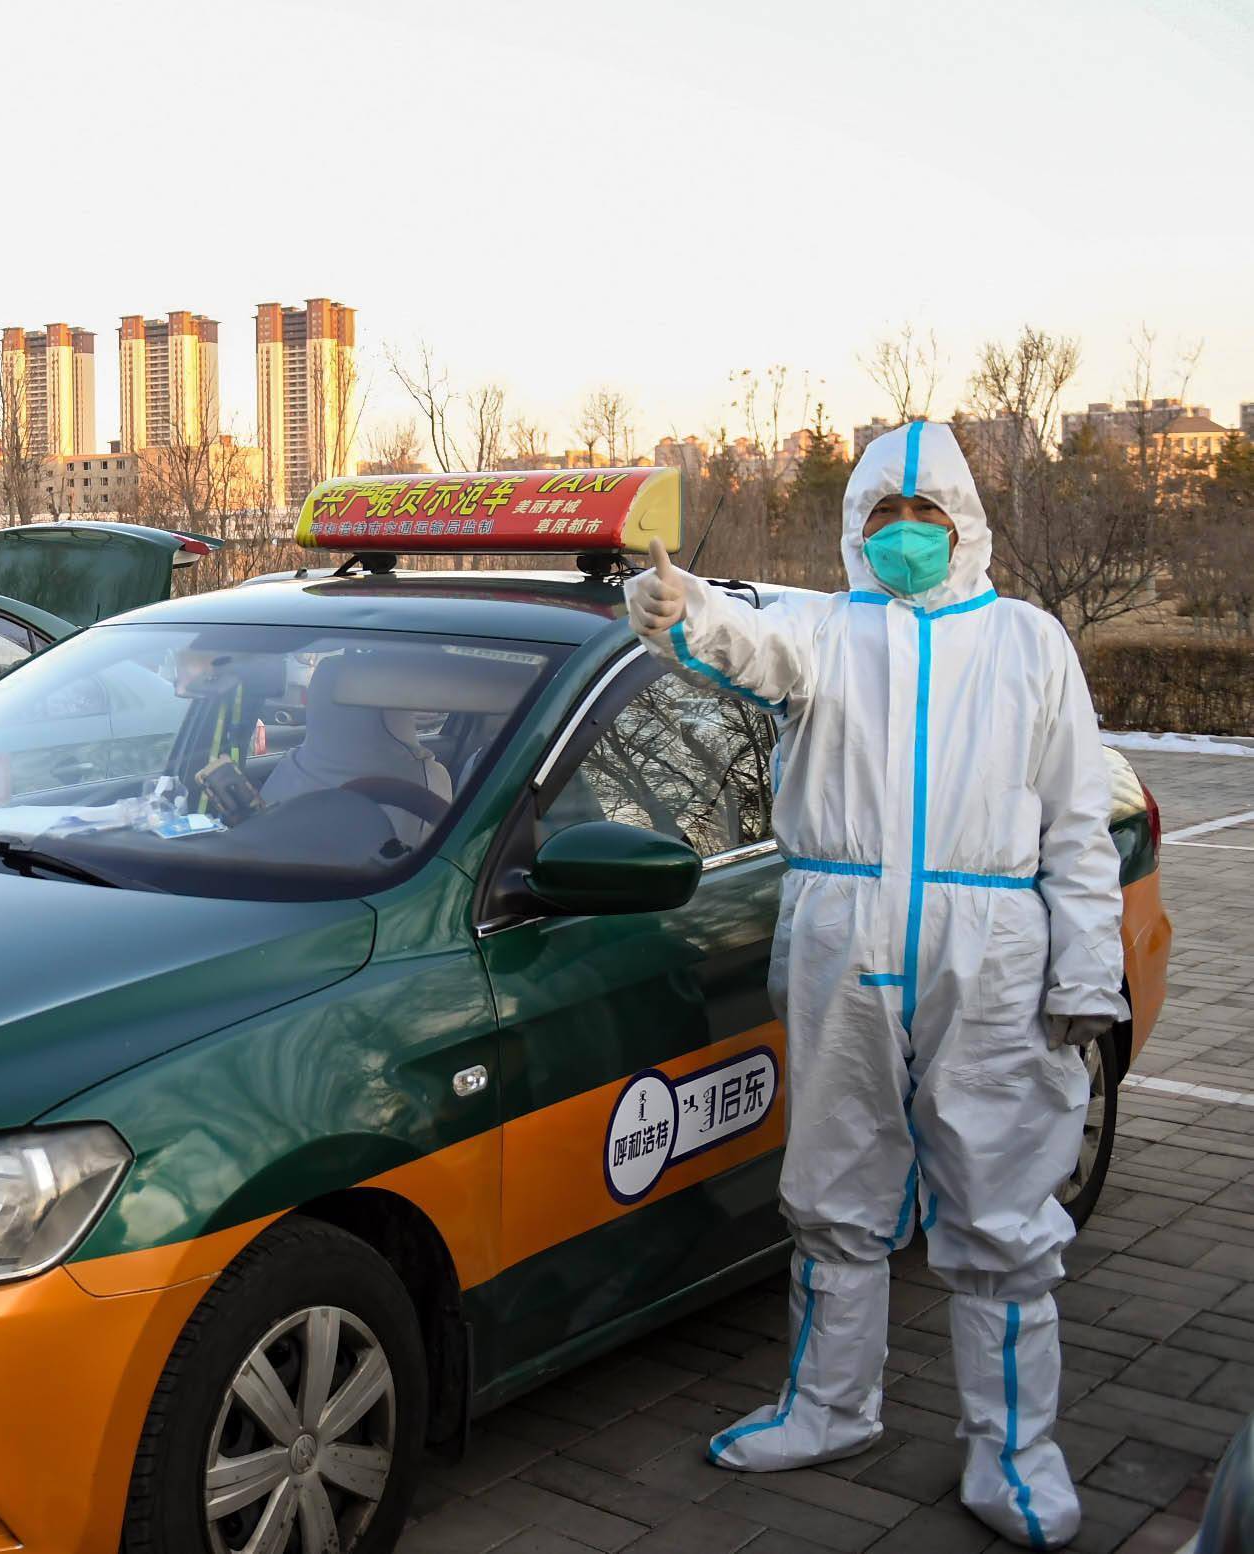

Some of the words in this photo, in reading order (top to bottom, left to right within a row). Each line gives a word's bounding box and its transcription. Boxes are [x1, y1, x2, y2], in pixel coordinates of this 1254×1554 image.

[313, 476, 526, 518] 共产党员示范车
[538, 473, 629, 493] TAXI
[512, 499, 582, 515] 美丽青城
[534, 518, 603, 534] 草原都市
[719, 1067, 767, 1125] 启东
[613, 1119, 670, 1168] 呼和浩特
